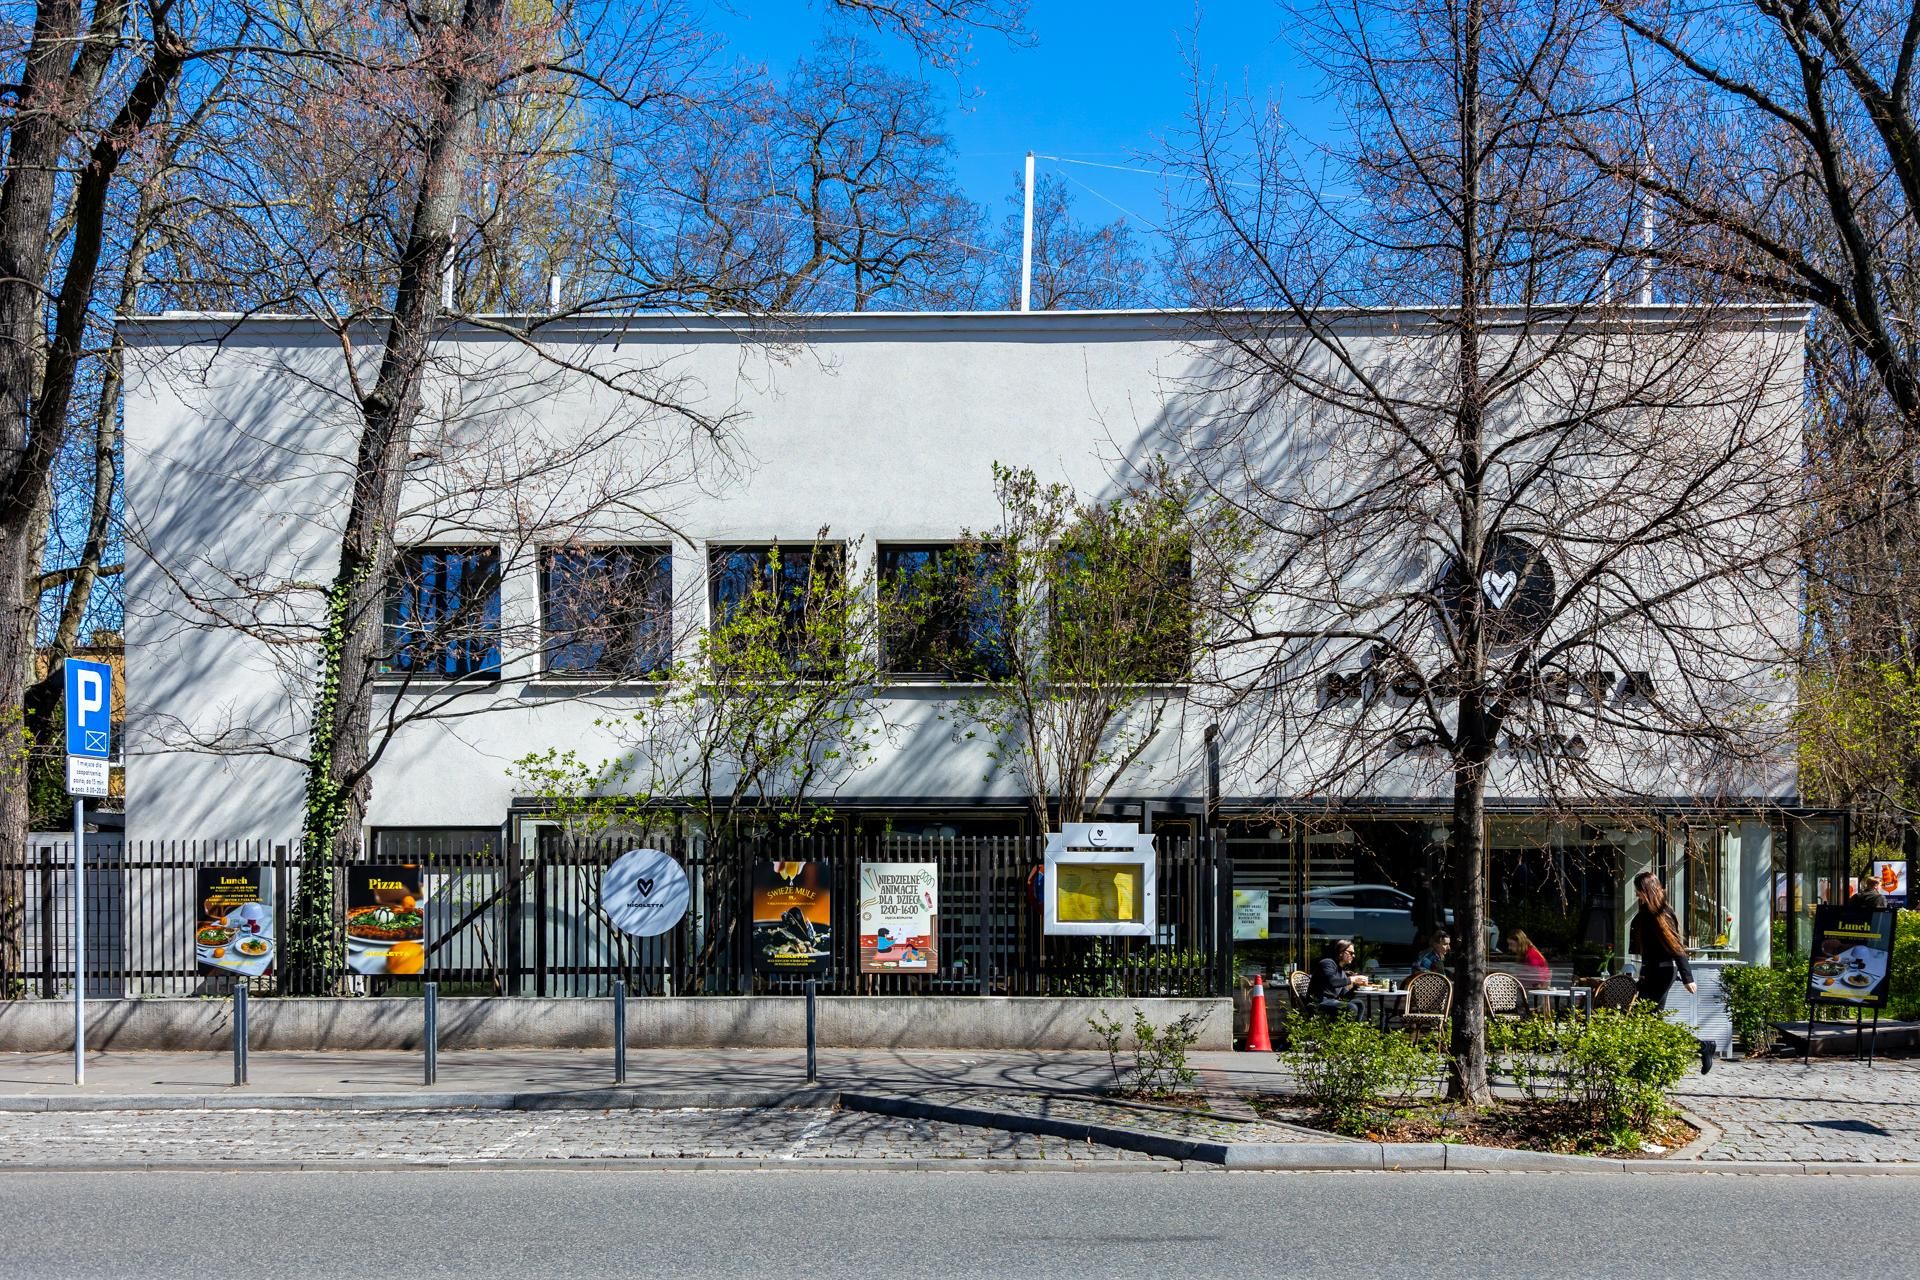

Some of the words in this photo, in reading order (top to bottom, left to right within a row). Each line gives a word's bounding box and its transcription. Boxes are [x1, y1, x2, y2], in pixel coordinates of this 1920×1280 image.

[78, 669, 102, 727] P
[220, 876, 248, 885] Lunch
[368, 878, 403, 890] Pizza
[879, 874, 921, 885] NIEDZIELNE
[795, 886, 817, 900] MULE
[880, 884, 919, 895] ANIMACJE
[878, 895, 893, 905] DLA
[880, 905, 919, 915] 12:00-16:00
[1838, 921, 1872, 931] Lunch
